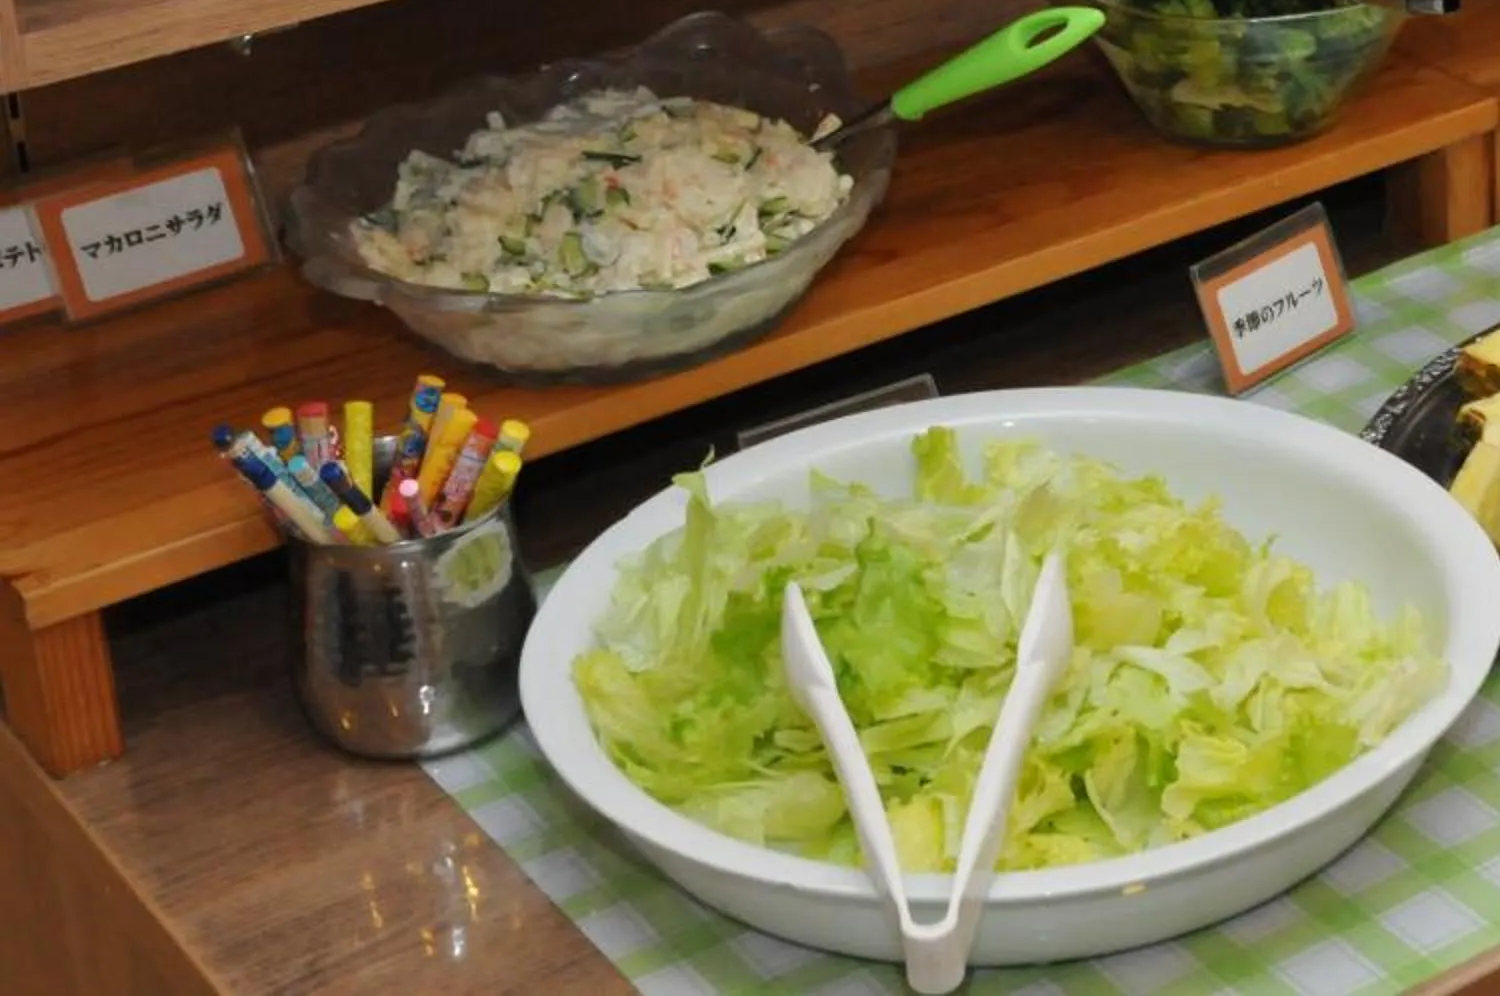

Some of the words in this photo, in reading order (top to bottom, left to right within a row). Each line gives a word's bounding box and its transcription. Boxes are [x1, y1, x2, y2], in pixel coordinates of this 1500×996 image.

[80, 203, 223, 259] マカロニサラダ
[0, 241, 42, 269] テト
